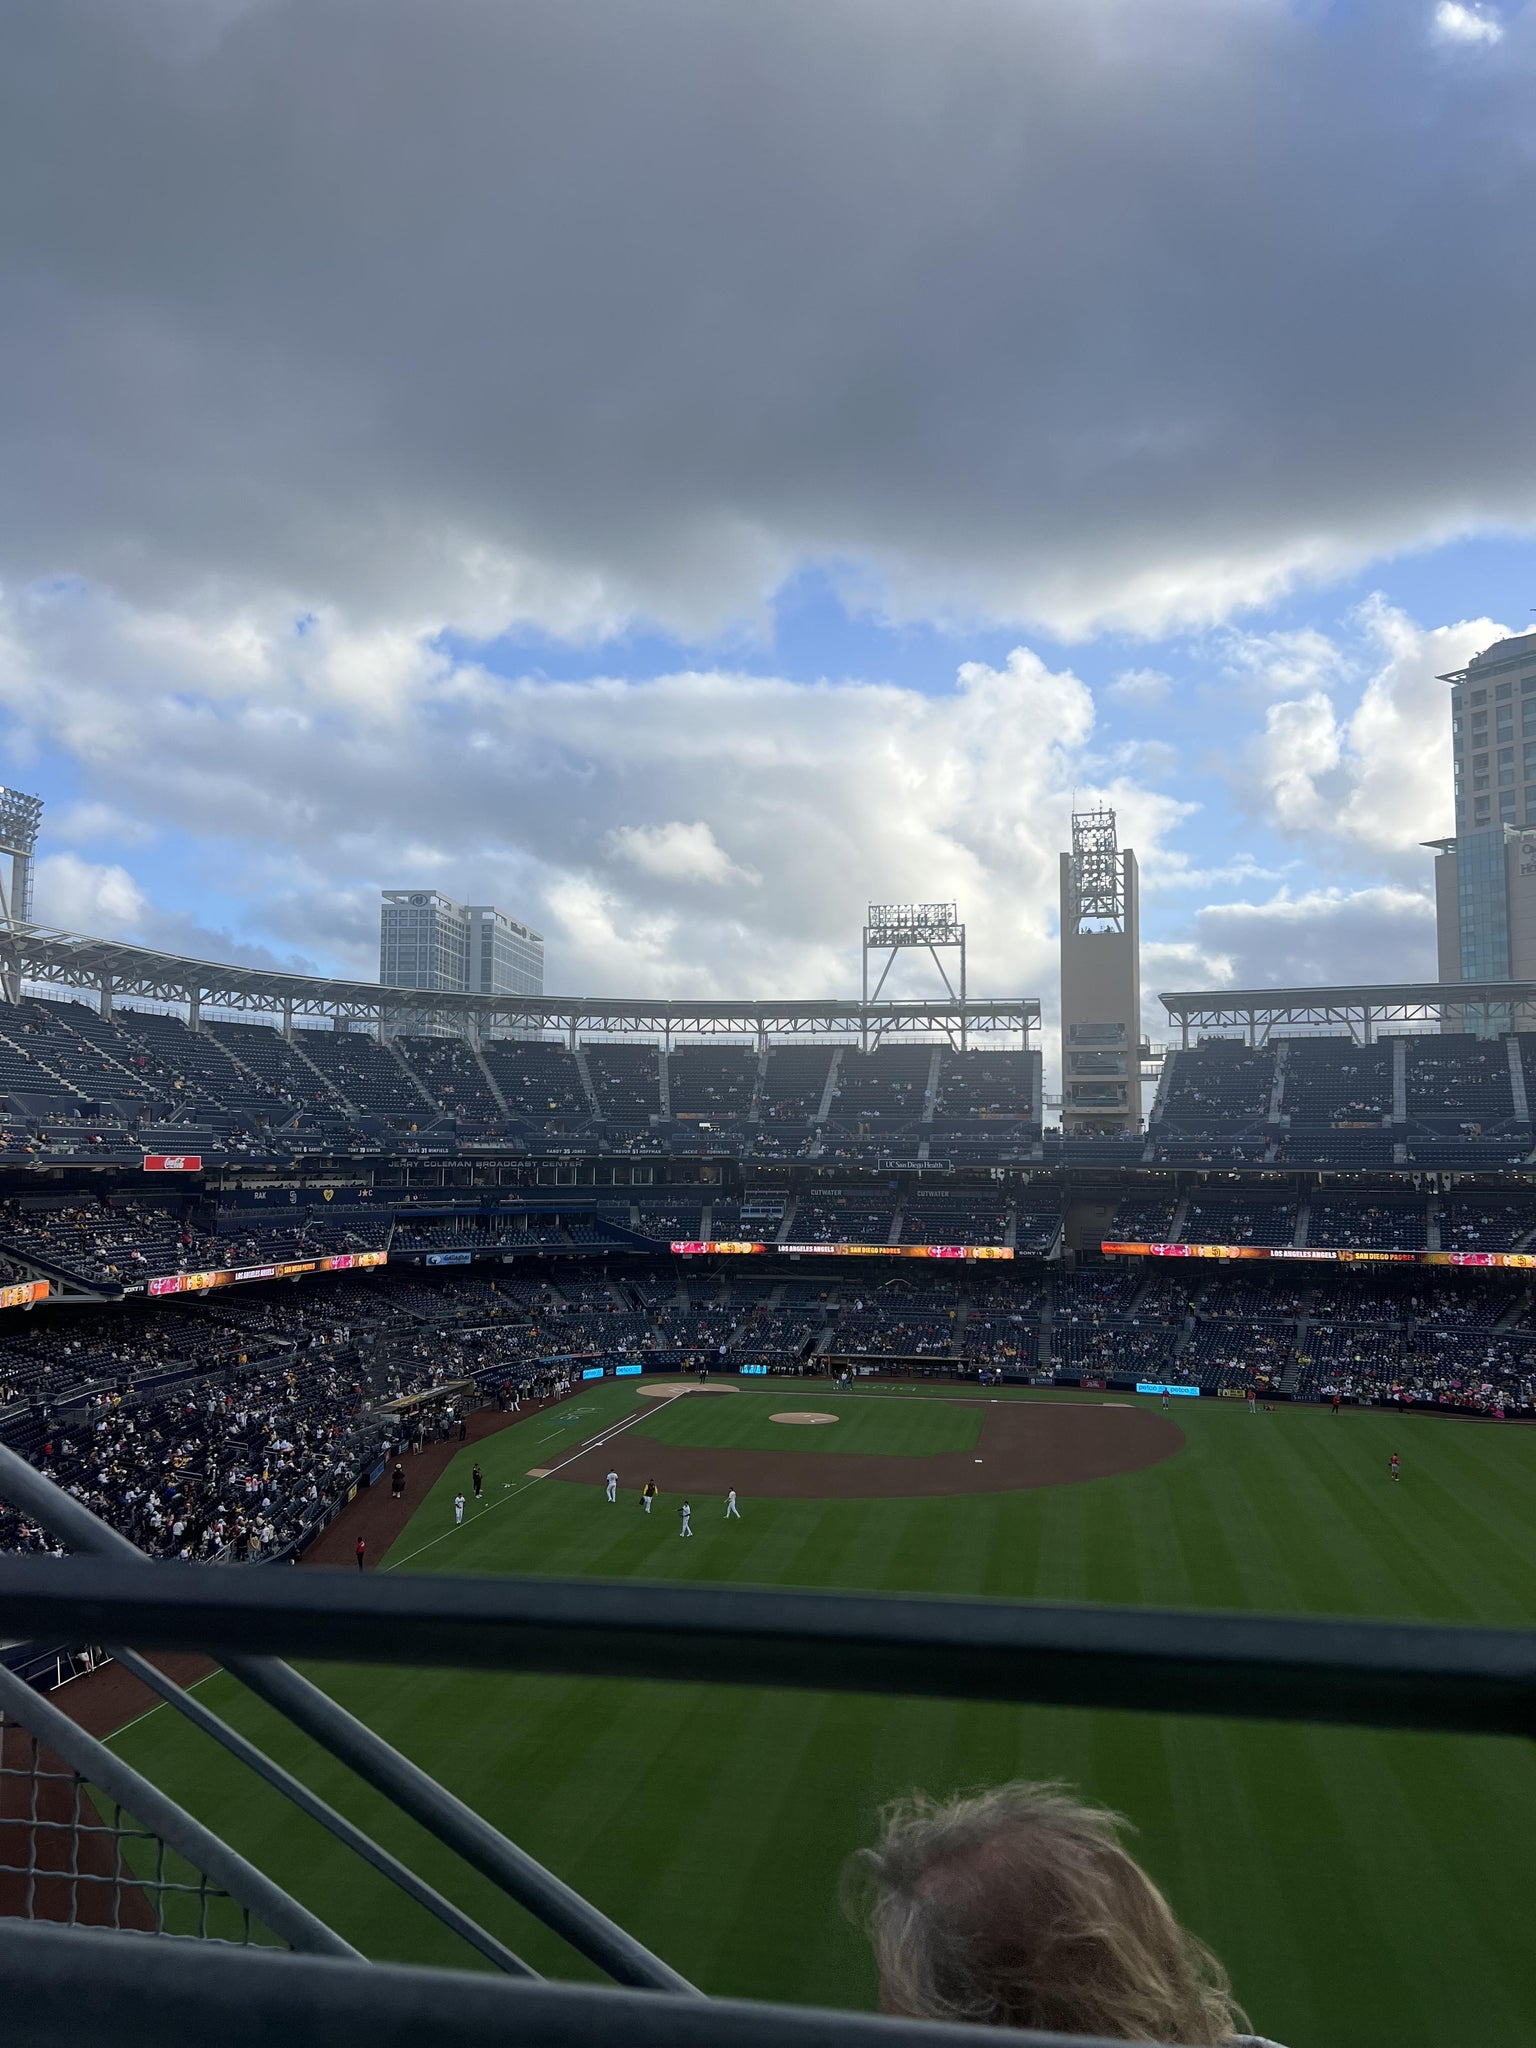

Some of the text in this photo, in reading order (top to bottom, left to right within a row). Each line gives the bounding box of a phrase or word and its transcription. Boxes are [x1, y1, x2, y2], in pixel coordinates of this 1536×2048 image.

[907, 1161, 923, 1169] Diego
[923, 1161, 943, 1169] Health
[814, 1245, 835, 1253] ANGELS
[1283, 1250, 1311, 1258] ANGELES
[1355, 1252, 1369, 1260] SAN
[1369, 1252, 1389, 1260] DIEGO
